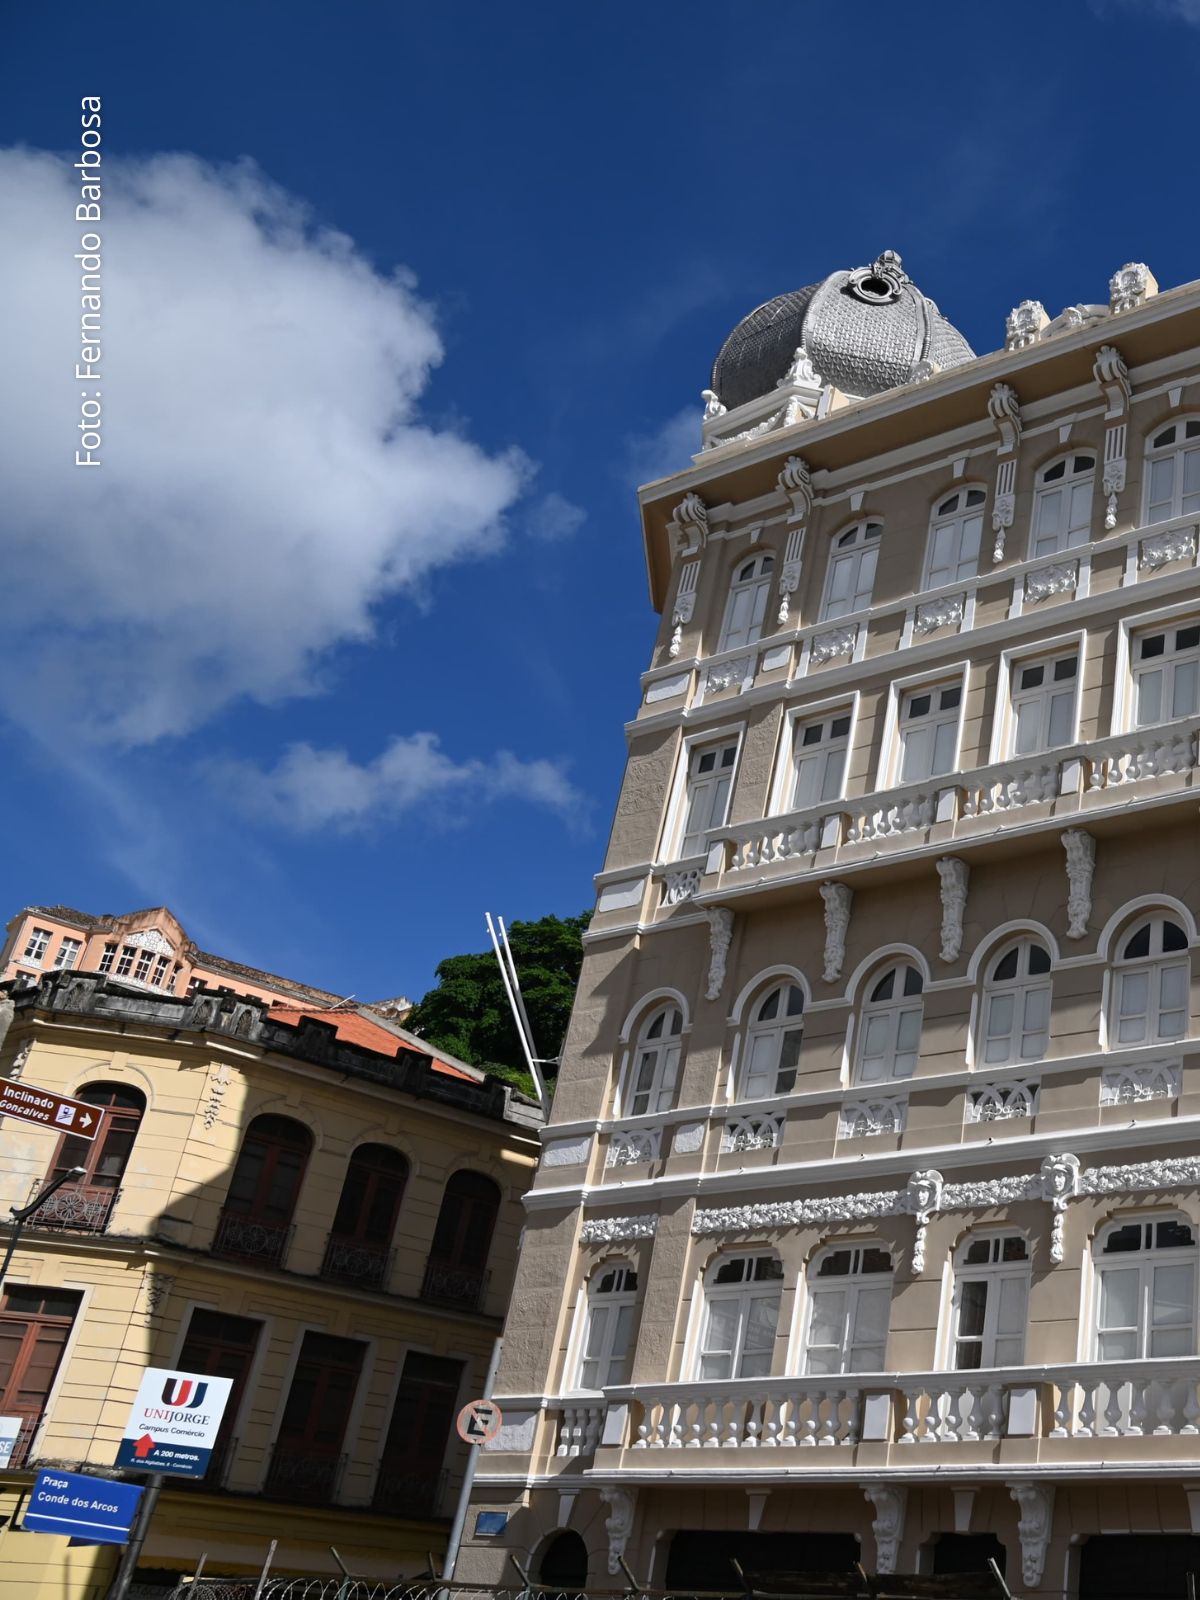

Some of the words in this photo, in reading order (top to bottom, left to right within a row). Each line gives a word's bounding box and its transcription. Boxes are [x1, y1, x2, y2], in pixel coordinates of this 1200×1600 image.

[4, 1086, 54, 1109] Inclinado
[144, 1408, 211, 1426] UNIJORGE
[139, 1423, 169, 1433] Campus
[160, 1450, 174, 1458] 200
[42, 1476, 69, 1489] Praça
[38, 1491, 69, 1505] Conde
[71, 1497, 89, 1508] dos
[90, 1500, 119, 1513] Arcos
